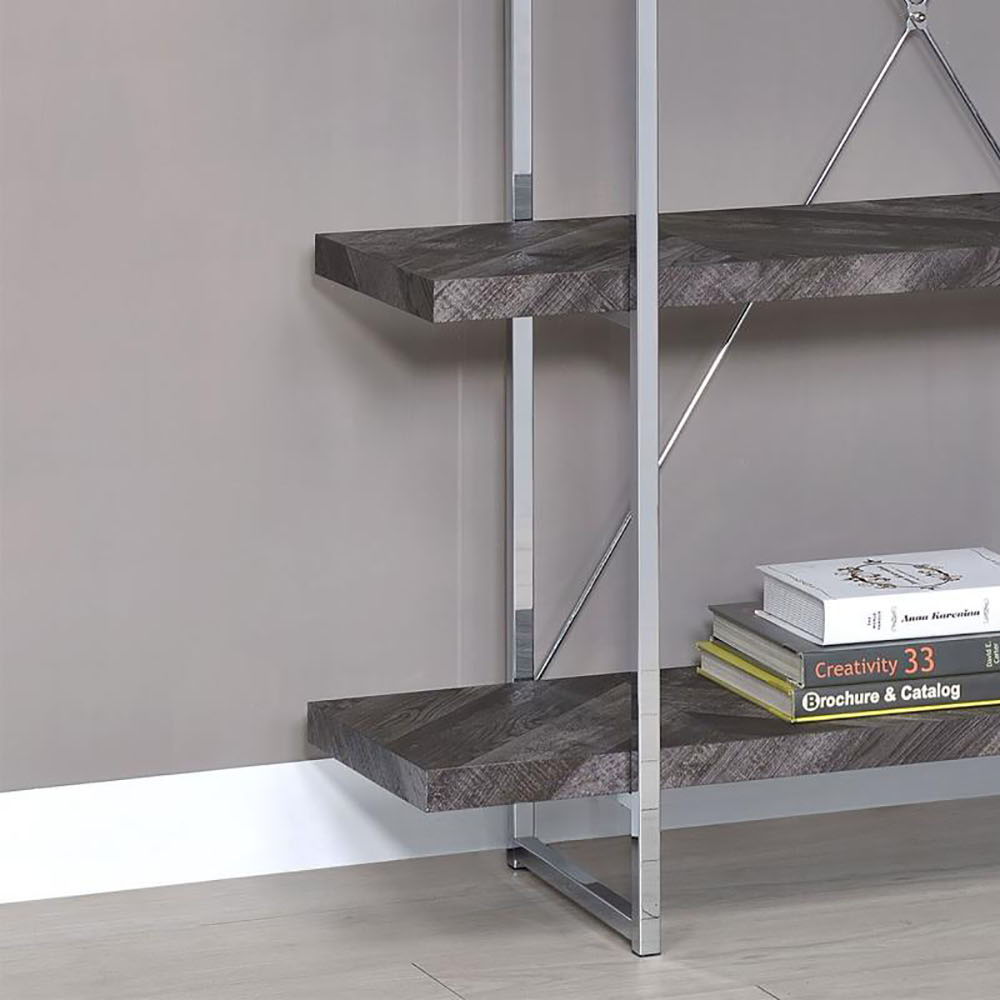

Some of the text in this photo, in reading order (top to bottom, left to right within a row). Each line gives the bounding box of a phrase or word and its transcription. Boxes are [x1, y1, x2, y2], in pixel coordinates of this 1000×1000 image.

[901, 614, 929, 623] Anna
[815, 646, 936, 679] Creativity 33
[802, 682, 961, 712] Brochure & Catalog
